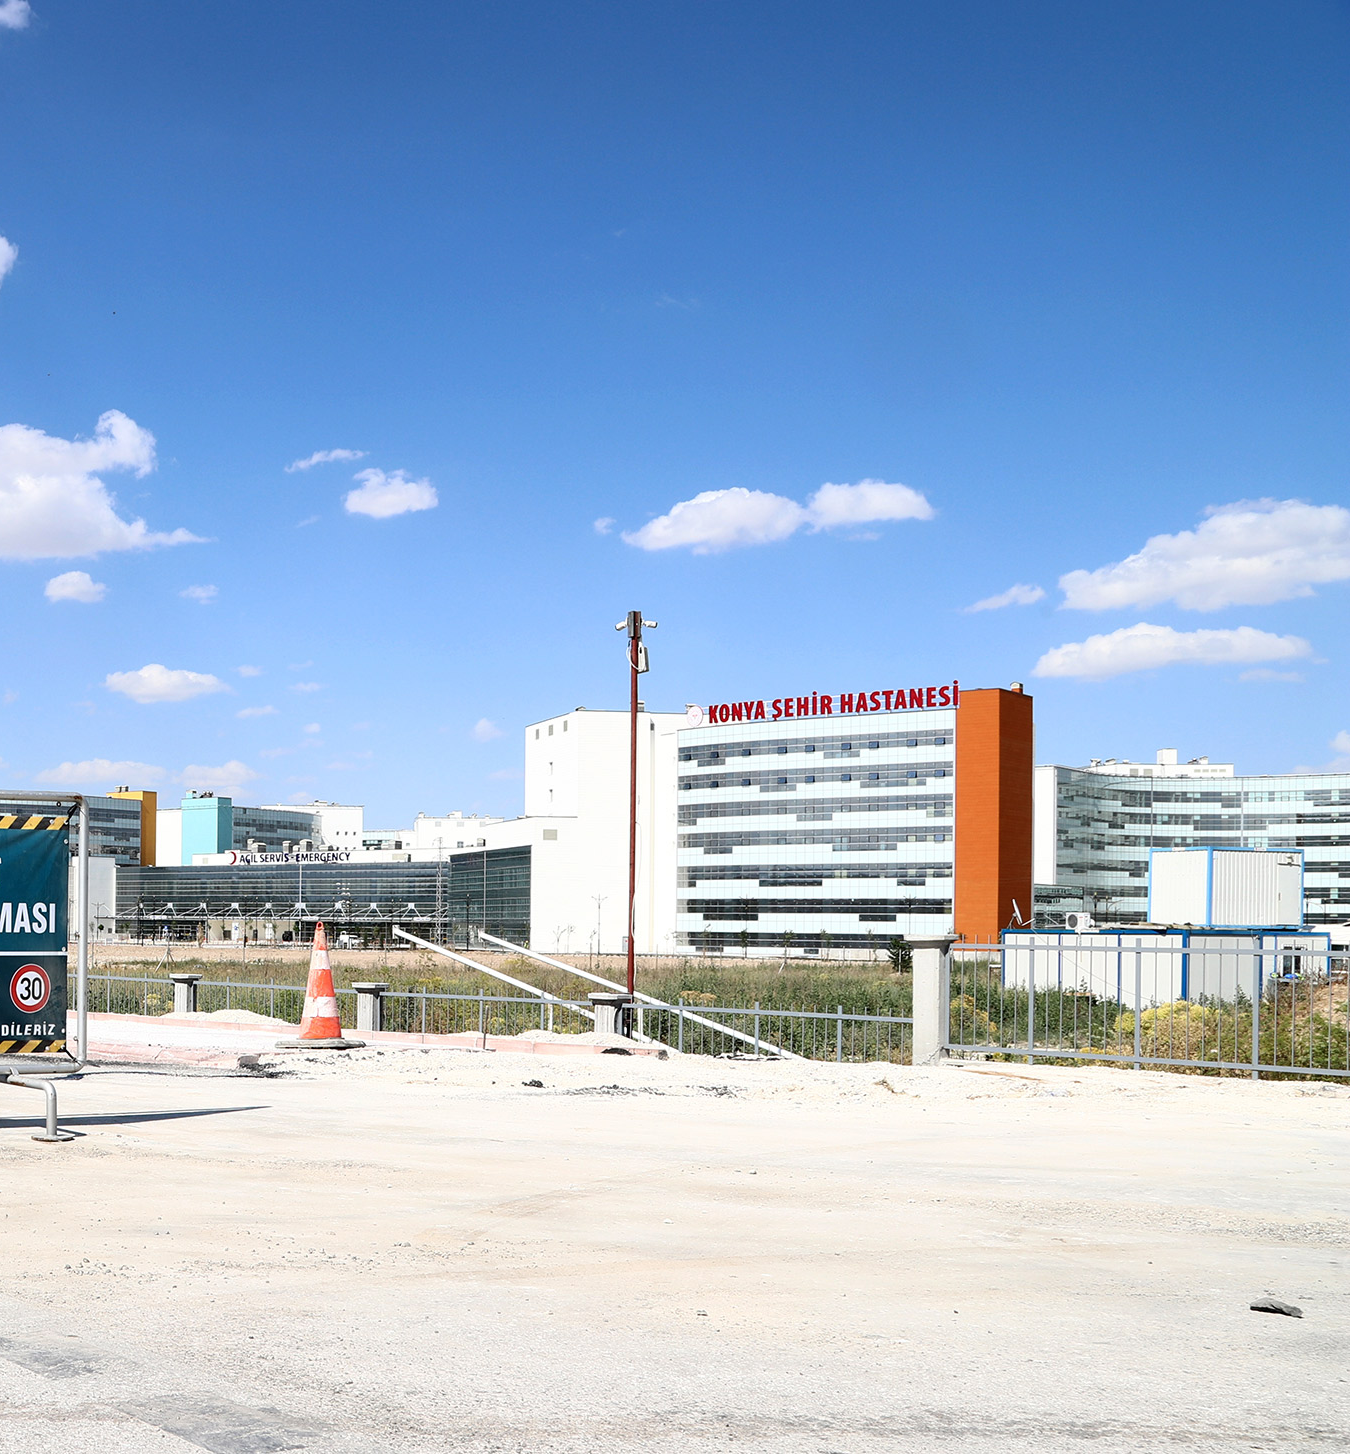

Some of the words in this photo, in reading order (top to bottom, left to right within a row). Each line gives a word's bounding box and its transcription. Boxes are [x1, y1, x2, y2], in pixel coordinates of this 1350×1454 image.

[708, 699, 766, 724] KONYA
[771, 690, 833, 721] ŞEHİR
[840, 679, 959, 714] HASTANESİ
[296, 852, 350, 862] EMERGENCY
[19, 977, 43, 1001] 30
[1, 1021, 56, 1036] DİLERİZ
